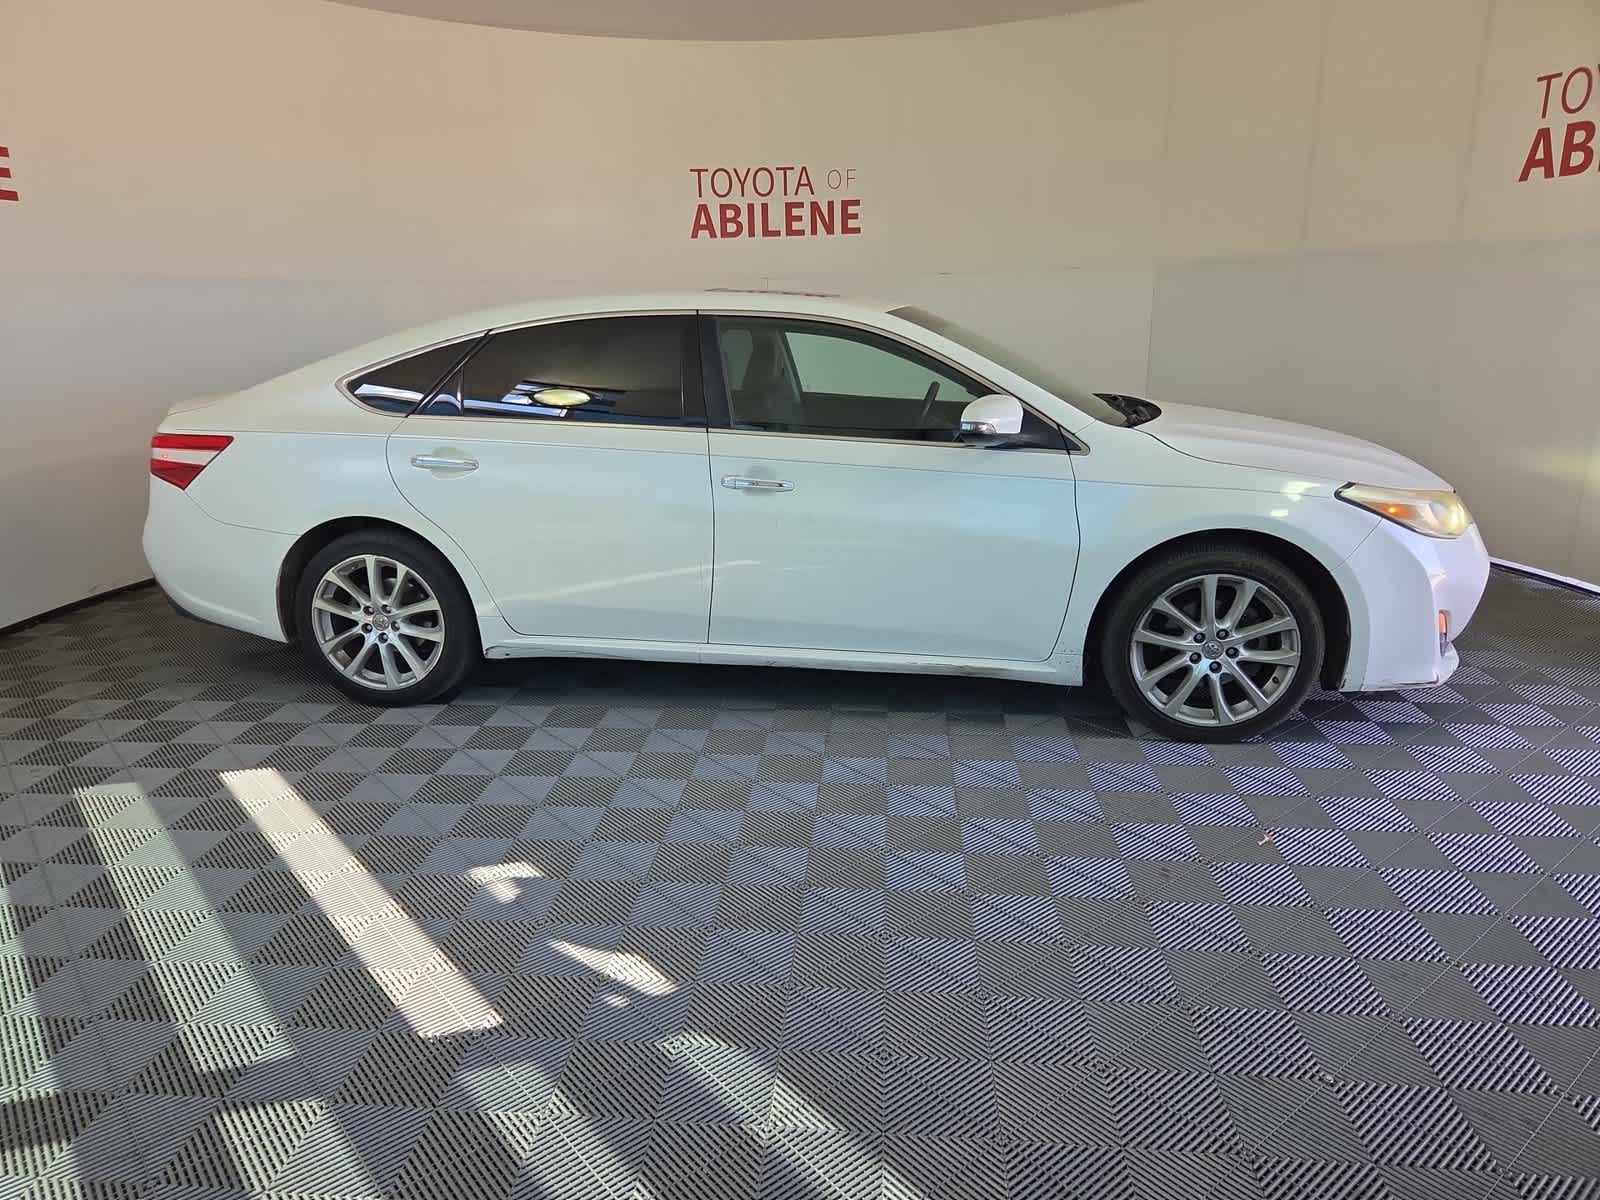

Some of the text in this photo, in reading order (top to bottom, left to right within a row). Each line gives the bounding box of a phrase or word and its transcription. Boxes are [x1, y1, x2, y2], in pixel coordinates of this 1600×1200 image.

[1536, 64, 1600, 119] TO
[1518, 120, 1600, 183] AB
[689, 166, 857, 198] TOYOTA OF
[690, 199, 862, 239] ABILENE
